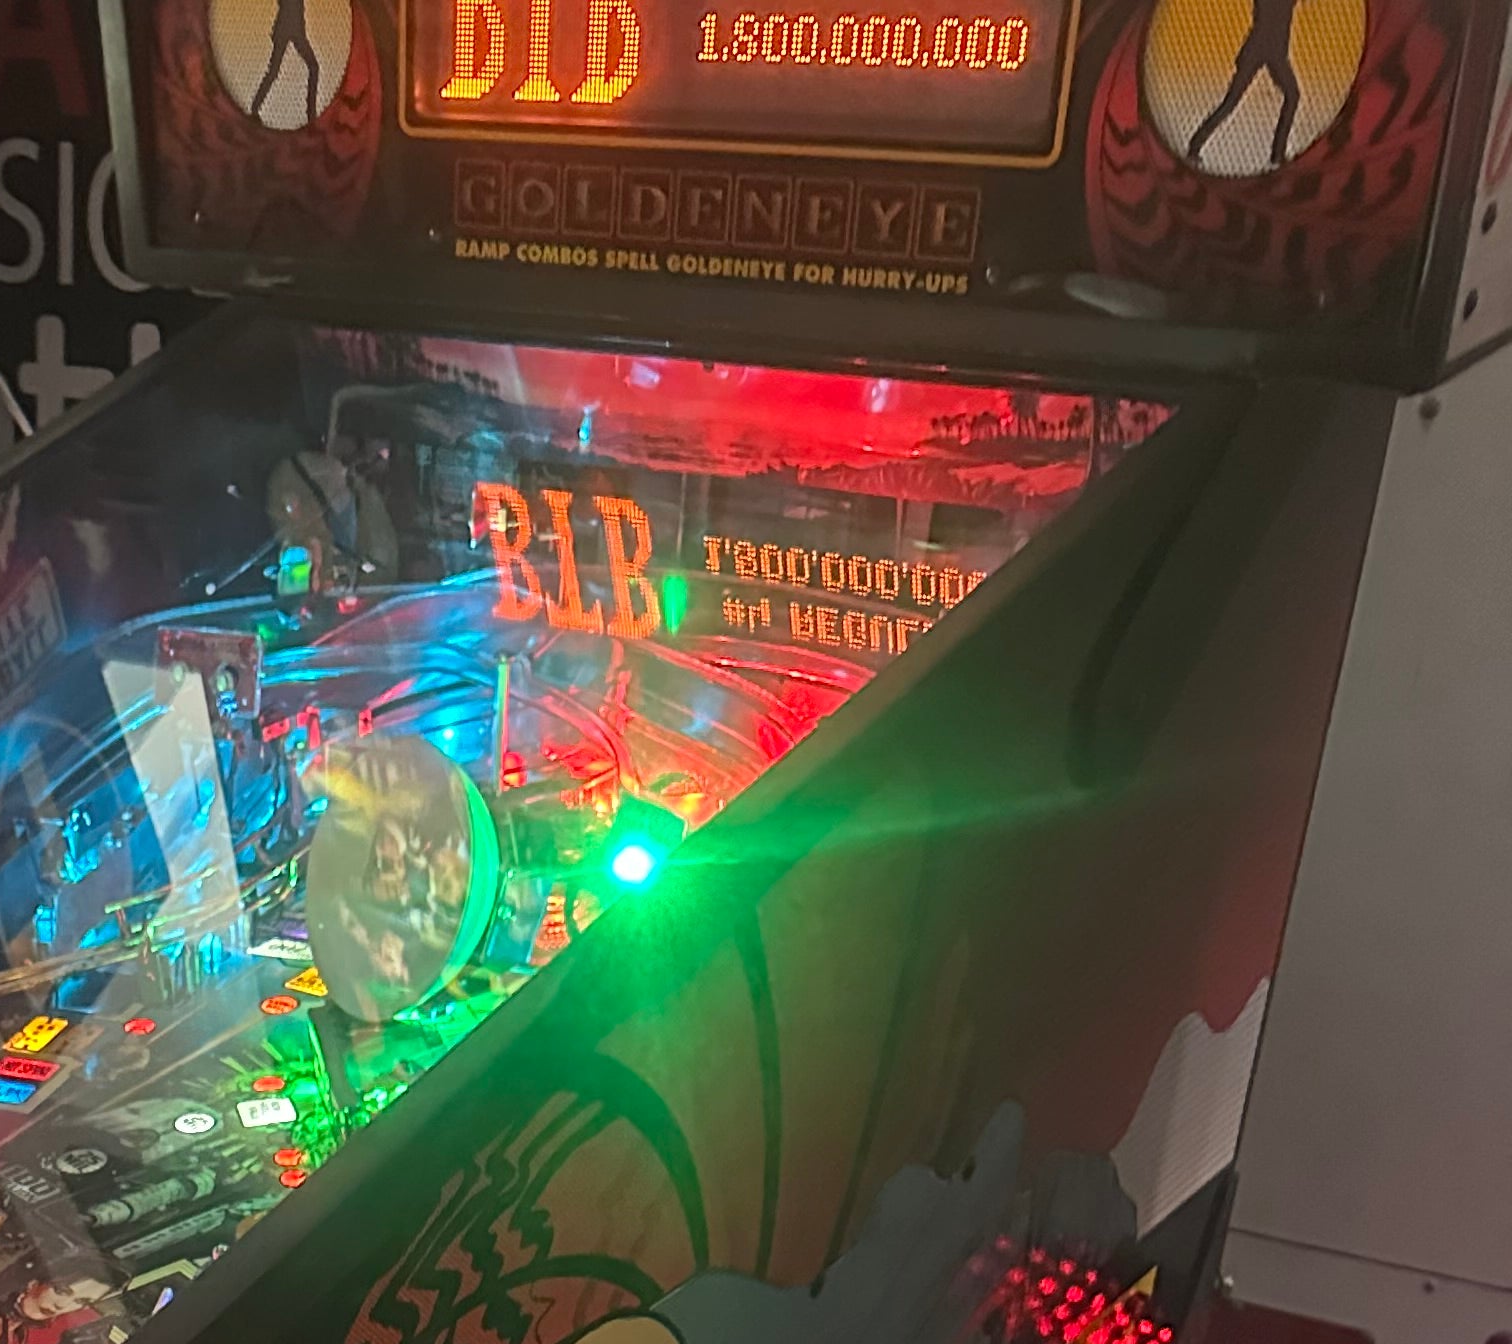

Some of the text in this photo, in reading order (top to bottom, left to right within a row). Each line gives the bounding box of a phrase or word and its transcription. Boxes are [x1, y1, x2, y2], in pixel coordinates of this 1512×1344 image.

[462, 174, 972, 250] GOLDENEYE
[455, 239, 969, 295] RAMP COMBOS SPELL GOLDENEYE FOR HURRY-UPS
